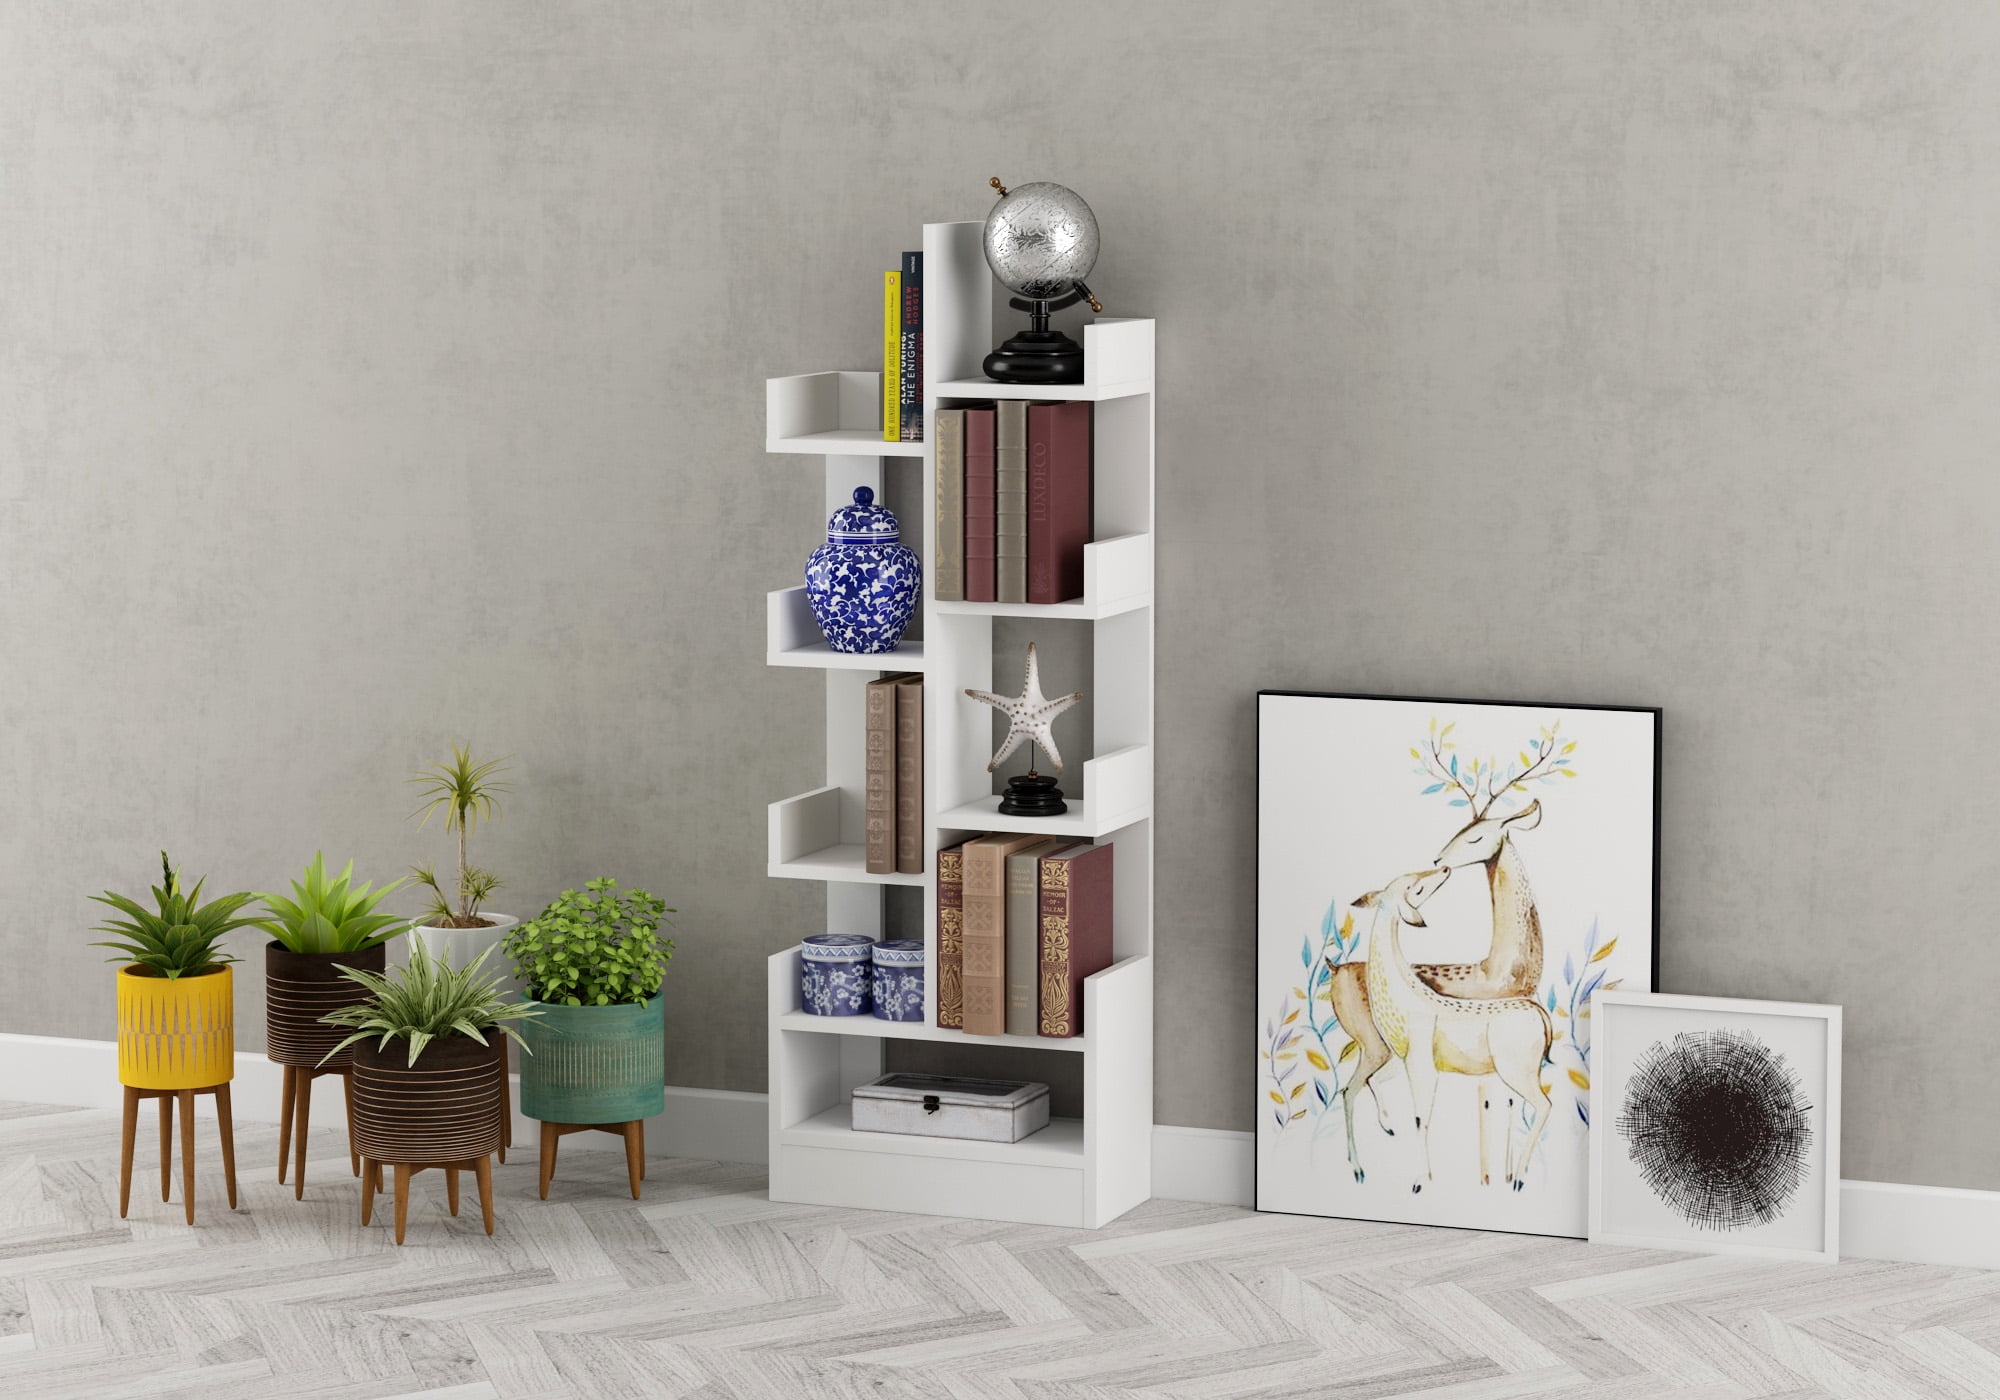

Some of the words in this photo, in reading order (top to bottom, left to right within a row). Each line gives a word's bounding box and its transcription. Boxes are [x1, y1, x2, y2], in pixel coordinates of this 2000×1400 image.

[907, 332, 916, 378] ENIGMA
[907, 383, 915, 404] THE
[1034, 442, 1047, 521] LUXDECO
